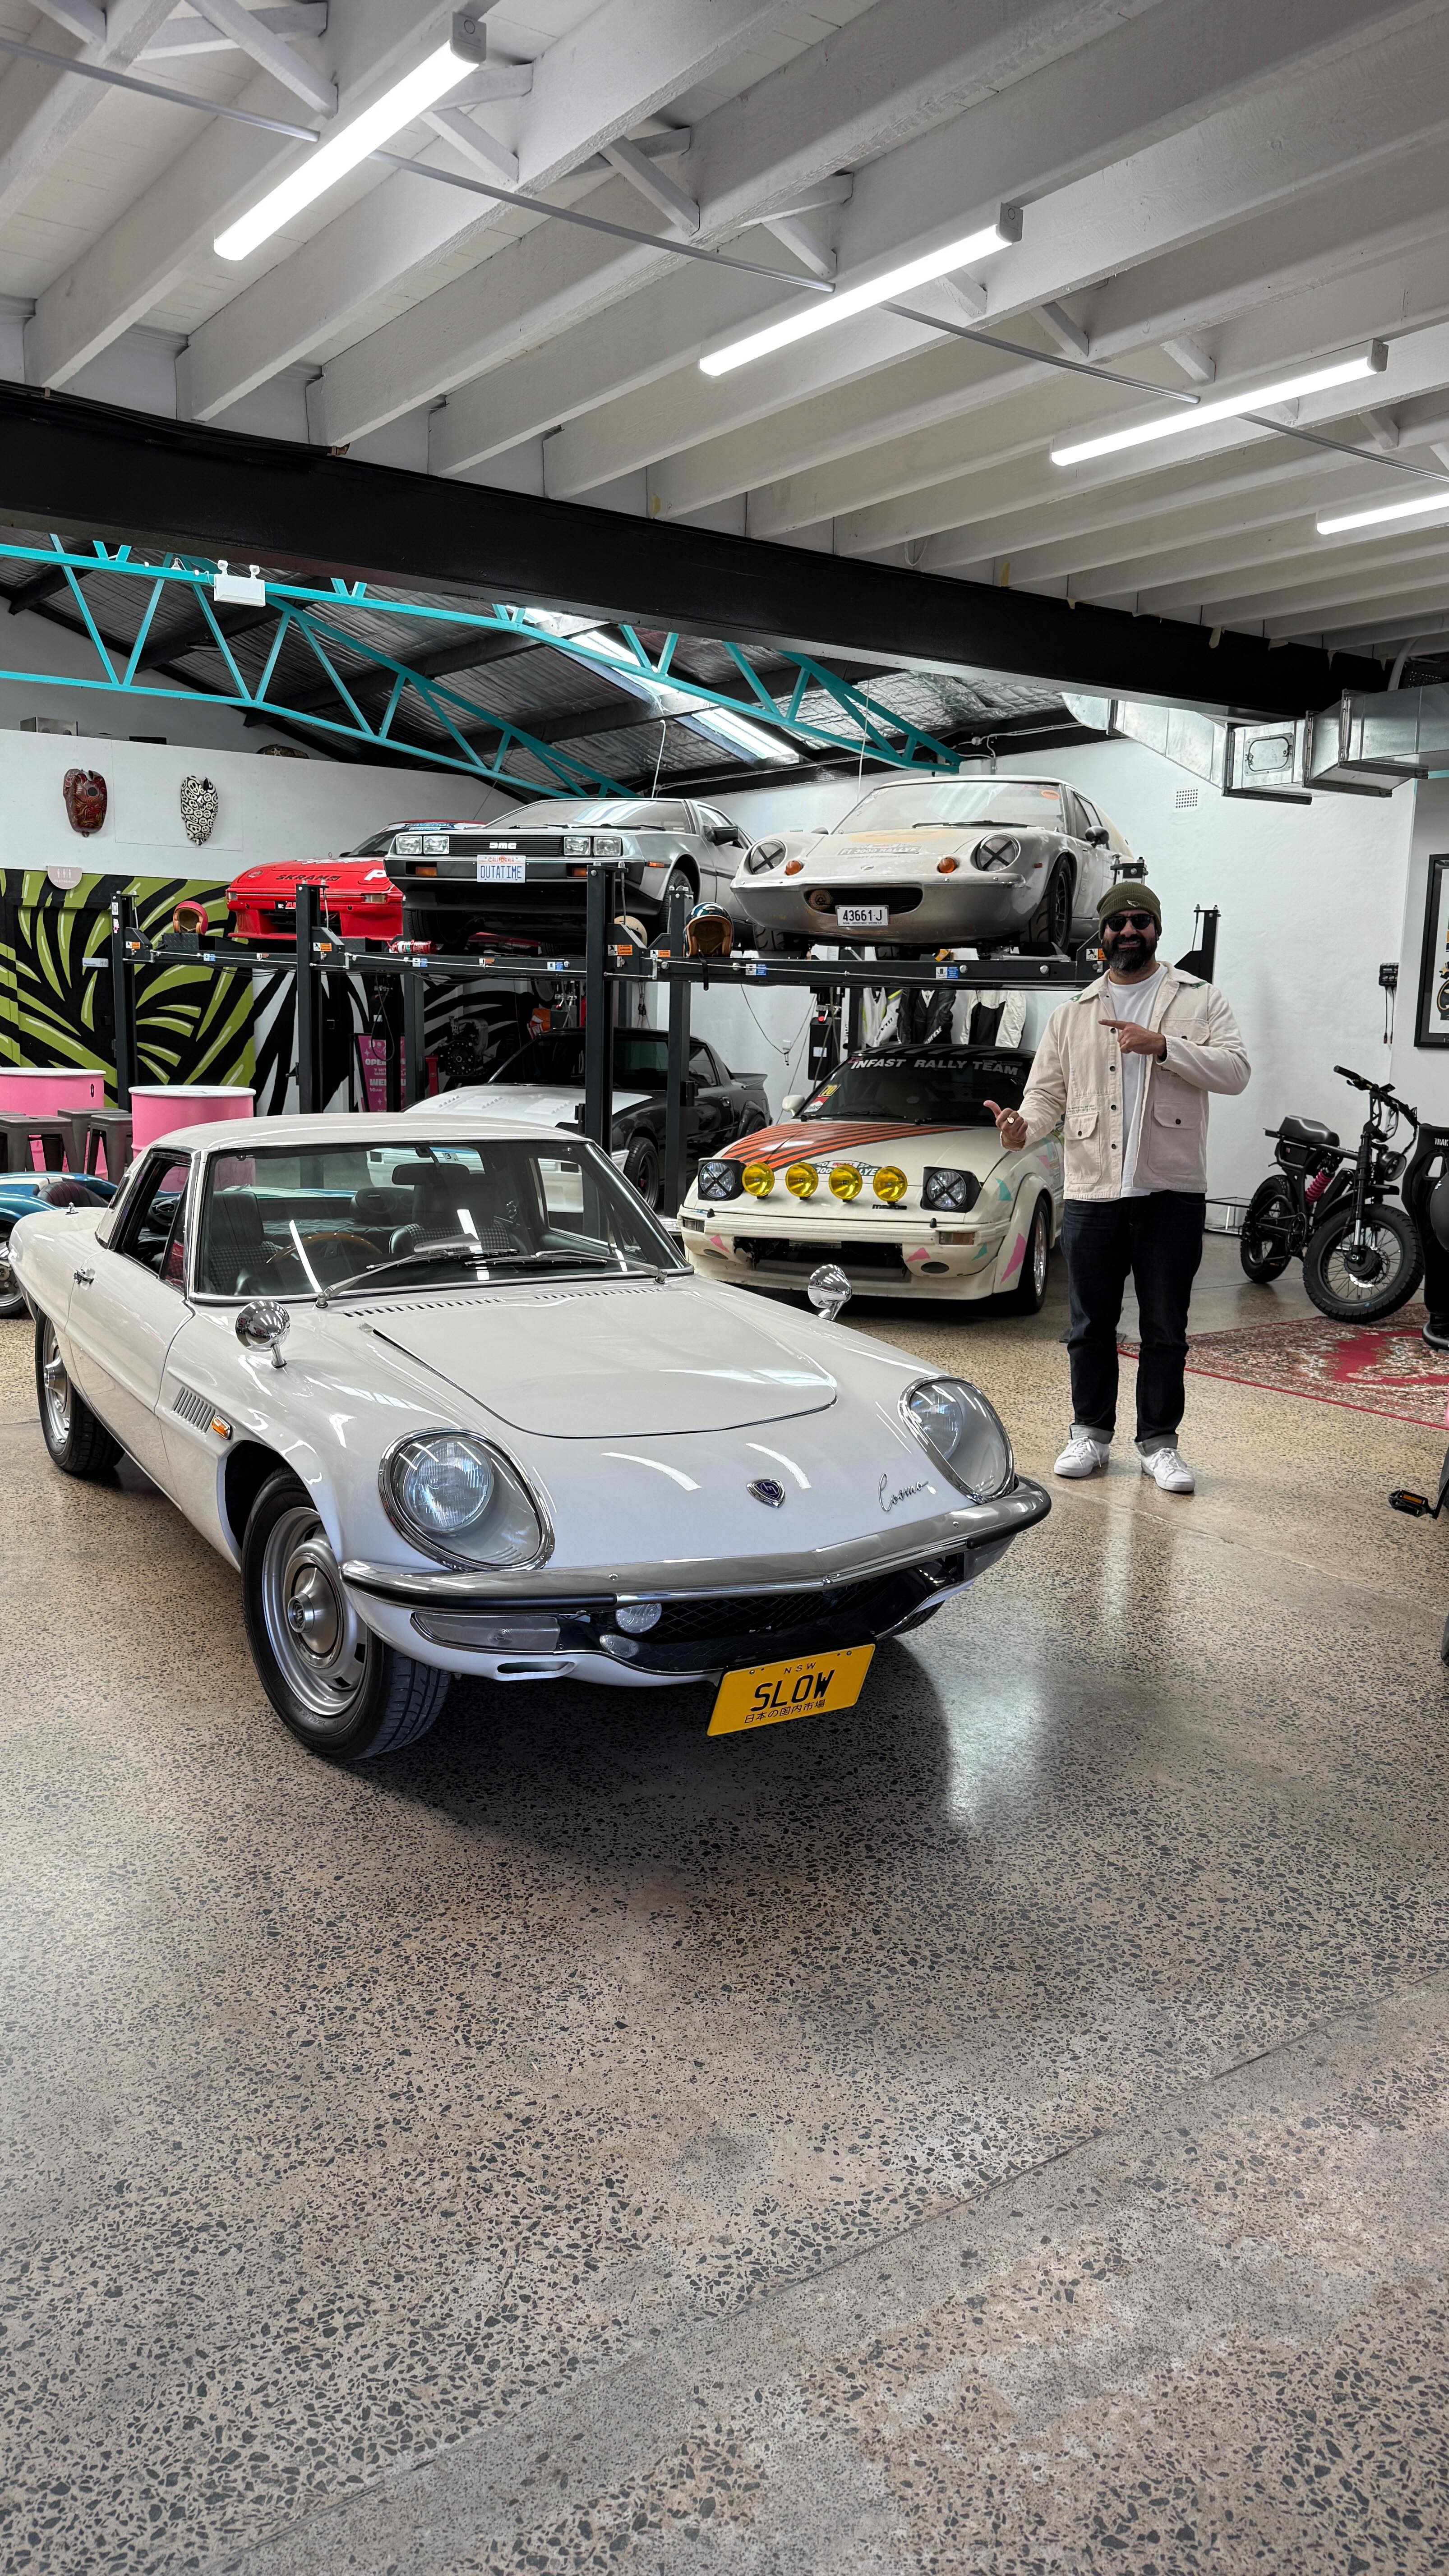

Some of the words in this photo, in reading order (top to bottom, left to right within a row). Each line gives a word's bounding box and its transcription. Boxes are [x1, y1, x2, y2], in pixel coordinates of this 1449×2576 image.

[480, 865, 522, 879] OUTATIME
[851, 1059, 906, 1069] INFAST
[914, 1059, 969, 1068] RALLY
[973, 1061, 1018, 1076] TEAM
[878, 1473, 929, 1512] Cosmo
[784, 1662, 816, 1674] NSW
[750, 1669, 835, 1711] SLOW
[744, 1699, 826, 1724] 日本の国内市場
